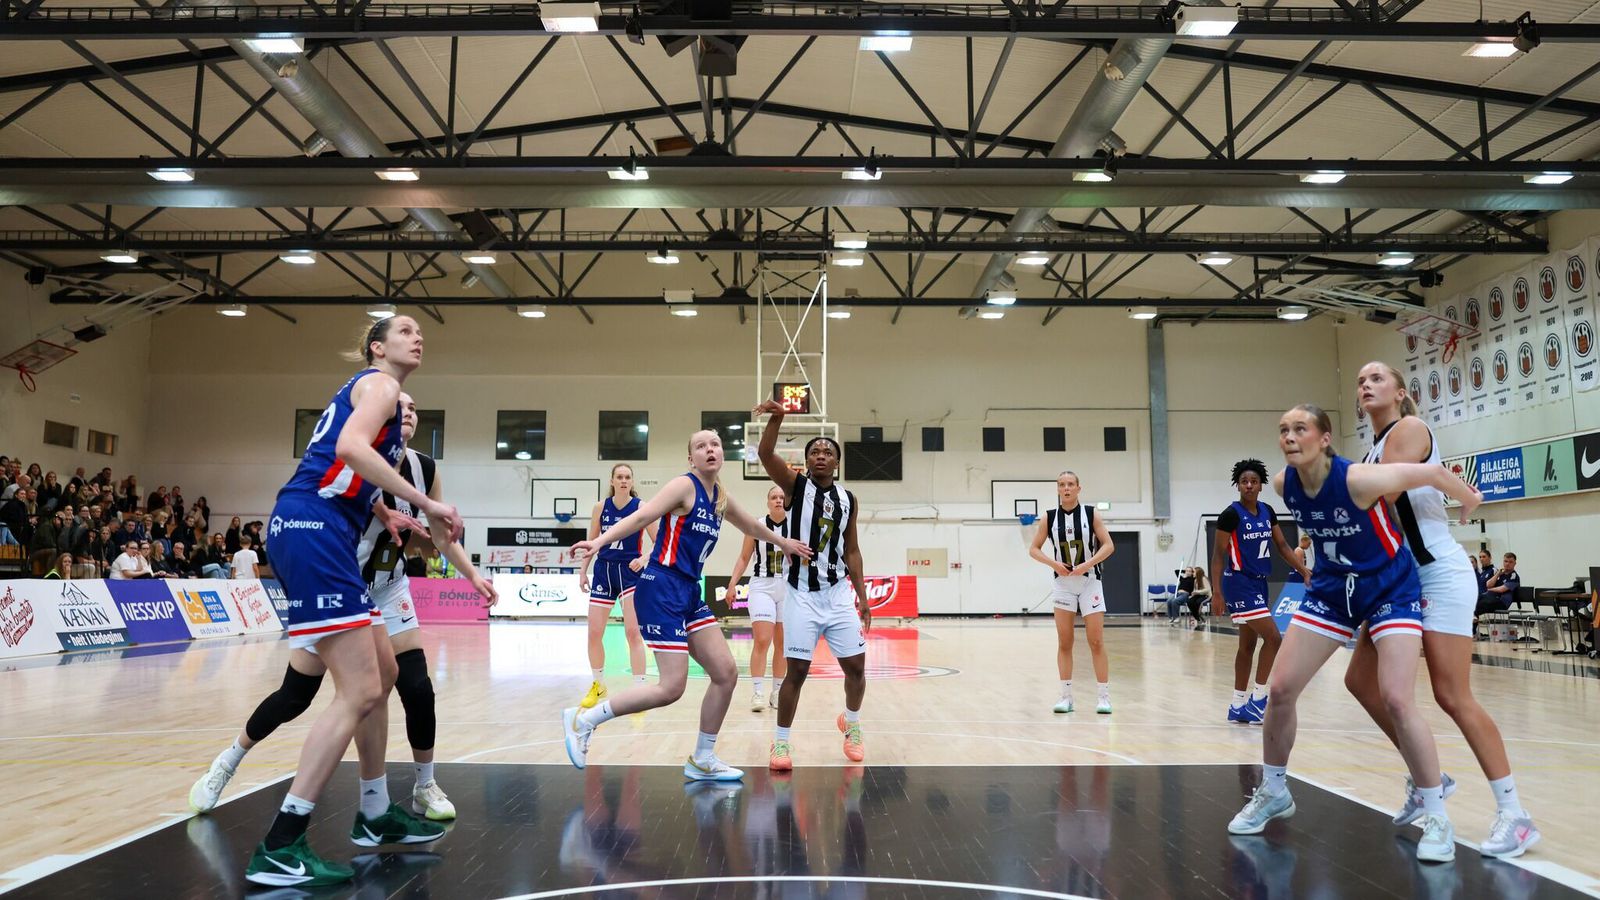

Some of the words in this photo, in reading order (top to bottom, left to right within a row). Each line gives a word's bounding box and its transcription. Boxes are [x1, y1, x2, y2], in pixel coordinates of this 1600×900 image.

[1574, 307, 1583, 316] 1977
[783, 398, 801, 411] 24
[1481, 468, 1521, 484] AKUREYRAR
[697, 507, 707, 519] 22
[283, 519, 324, 530] ÞÓRUKOT
[817, 517, 834, 552] 7
[1060, 540, 1083, 567] 17
[439, 588, 480, 600] BÓNUS
[59, 607, 111, 627] KÆNAN
[120, 601, 175, 621] NESSKIP
[788, 646, 811, 654] unbroken
